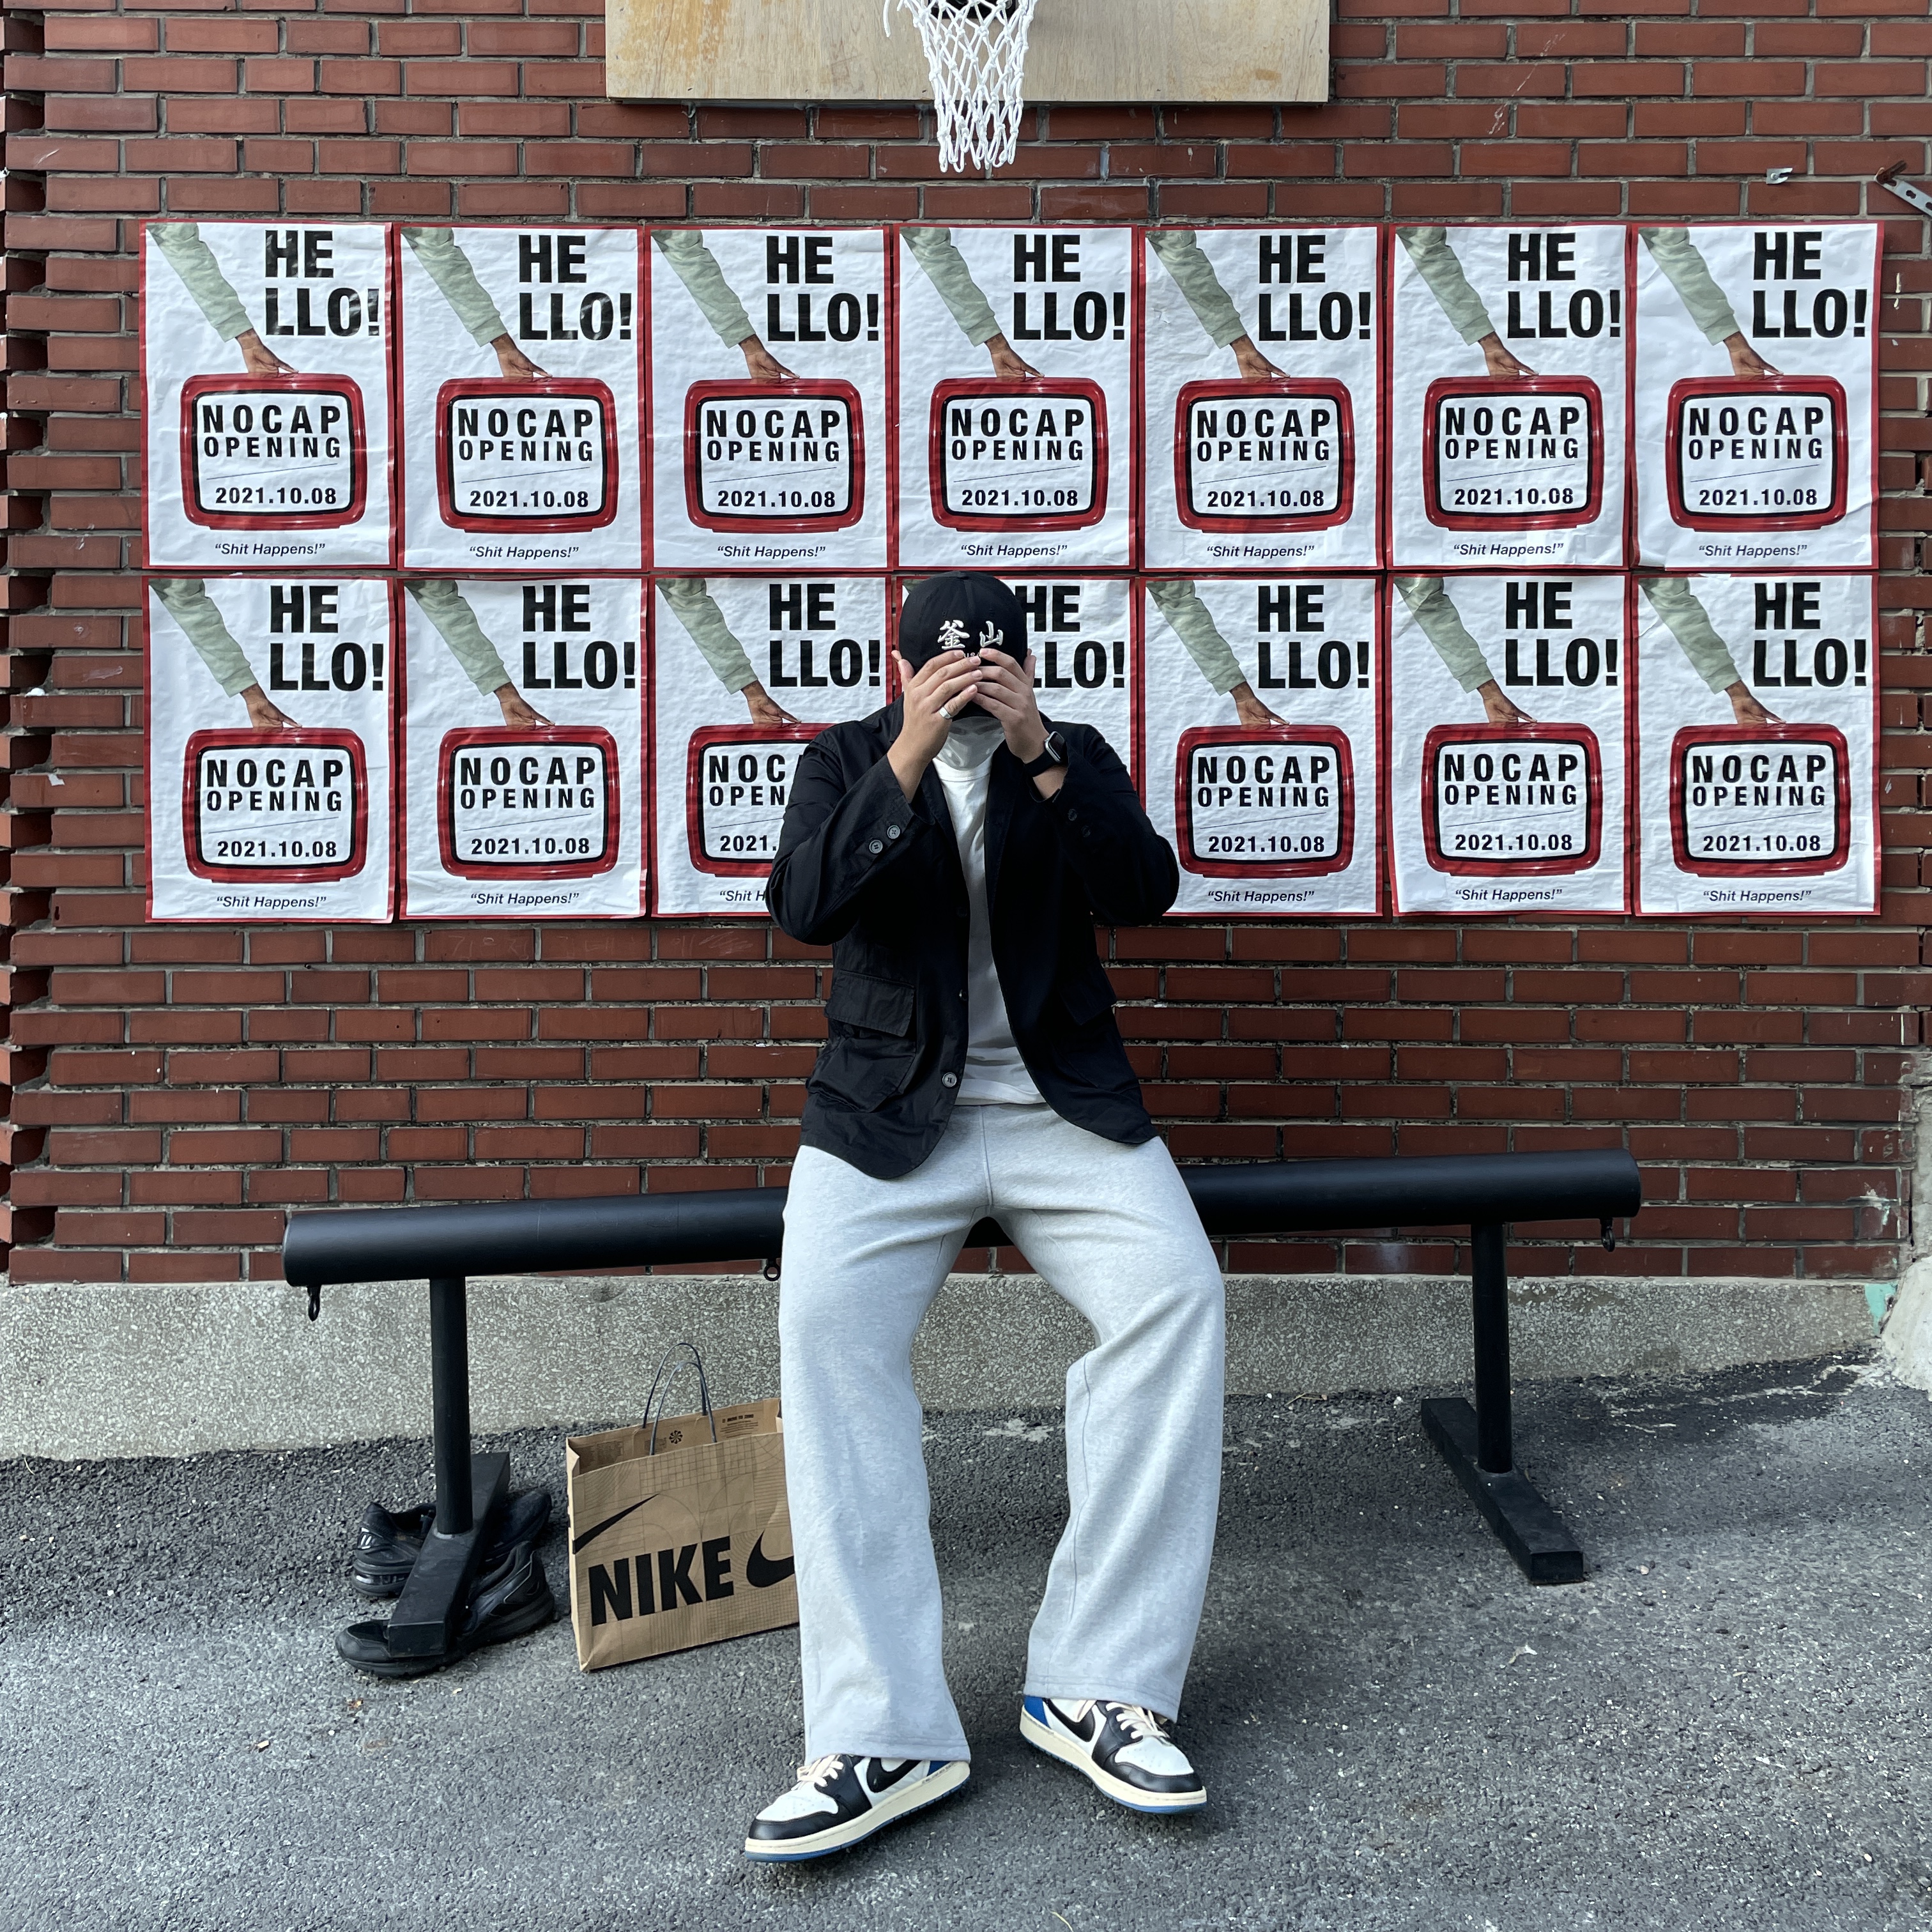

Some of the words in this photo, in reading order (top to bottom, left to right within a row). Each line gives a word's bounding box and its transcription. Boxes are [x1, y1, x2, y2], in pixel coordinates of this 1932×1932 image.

[265, 229, 334, 279] HE
[518, 234, 587, 284] HE
[766, 235, 834, 284] HE
[1013, 234, 1081, 282] HE
[1259, 234, 1326, 284] HE
[1508, 232, 1576, 282] HE
[1753, 231, 1822, 280] HE
[264, 287, 381, 337] LLO!
[519, 292, 632, 341] LLO!
[767, 293, 879, 342] LLO!
[1013, 291, 1126, 341] LLO!
[1259, 291, 1371, 342] LLO!
[1507, 289, 1621, 339] LLO!
[1752, 288, 1867, 339] LLO!
[202, 404, 341, 434] NOCAP
[457, 408, 593, 438] NOCAP
[706, 410, 840, 438] NOCAP
[951, 408, 1084, 437] NOCAP
[1197, 409, 1330, 438] NOCAP
[1445, 406, 1580, 436] NOCAP
[1689, 406, 1823, 436] NOCAP
[204, 436, 340, 458] OPENING
[459, 440, 593, 461] OPENING
[707, 440, 839, 462] OPENING
[951, 439, 1083, 461] OPENING
[1197, 440, 1330, 462] OPENING
[1445, 438, 1578, 459] OPENING
[1689, 438, 1823, 461] OPENING
[215, 487, 337, 505] 2021.10.08
[470, 490, 588, 508] 2021.10.08
[717, 490, 836, 508] 2021.10.08
[962, 489, 1078, 507] 2021.10.08
[1207, 490, 1324, 507] 2021.10.08
[1454, 487, 1574, 505] 2021.10.08
[1699, 489, 1817, 506] 2021.10.08
[270, 585, 339, 634] HE
[522, 584, 591, 632] HE
[769, 583, 836, 631] HE
[1015, 585, 1081, 633] HE
[1257, 585, 1324, 632] HE
[1505, 581, 1573, 629] HE
[1754, 581, 1821, 631] HE
[937, 619, 1004, 650] 釜山
[270, 642, 384, 692] LLO!
[523, 641, 636, 689] LLO!
[769, 638, 880, 687] LLO!
[1032, 640, 1125, 689] LO!
[1257, 640, 1369, 689] LLO!
[1505, 638, 1618, 687] LLO!
[1753, 638, 1867, 687] LLO!
[206, 759, 343, 788] NOCAP
[460, 756, 595, 786] NOCAP
[709, 754, 803, 783] NOC
[1197, 755, 1330, 784] NOCAP
[1444, 753, 1578, 782] NOCAP
[1692, 755, 1826, 783] NOCAP
[206, 790, 342, 811] OPENING
[461, 787, 594, 809] OPENING
[709, 785, 785, 807] OPEN
[1197, 786, 1329, 808] OPENING
[1445, 785, 1577, 806] OPENING
[1692, 785, 1825, 807] OPENING
[217, 841, 337, 857] 2021.10.08
[471, 838, 590, 855] 2021.10.08
[719, 834, 777, 852] 2021.
[1208, 835, 1325, 852] 2021.10.08
[1455, 834, 1572, 851] 2021.10.08
[1703, 834, 1821, 852] 2021.10.08
[587, 1535, 735, 1627] NIKE
